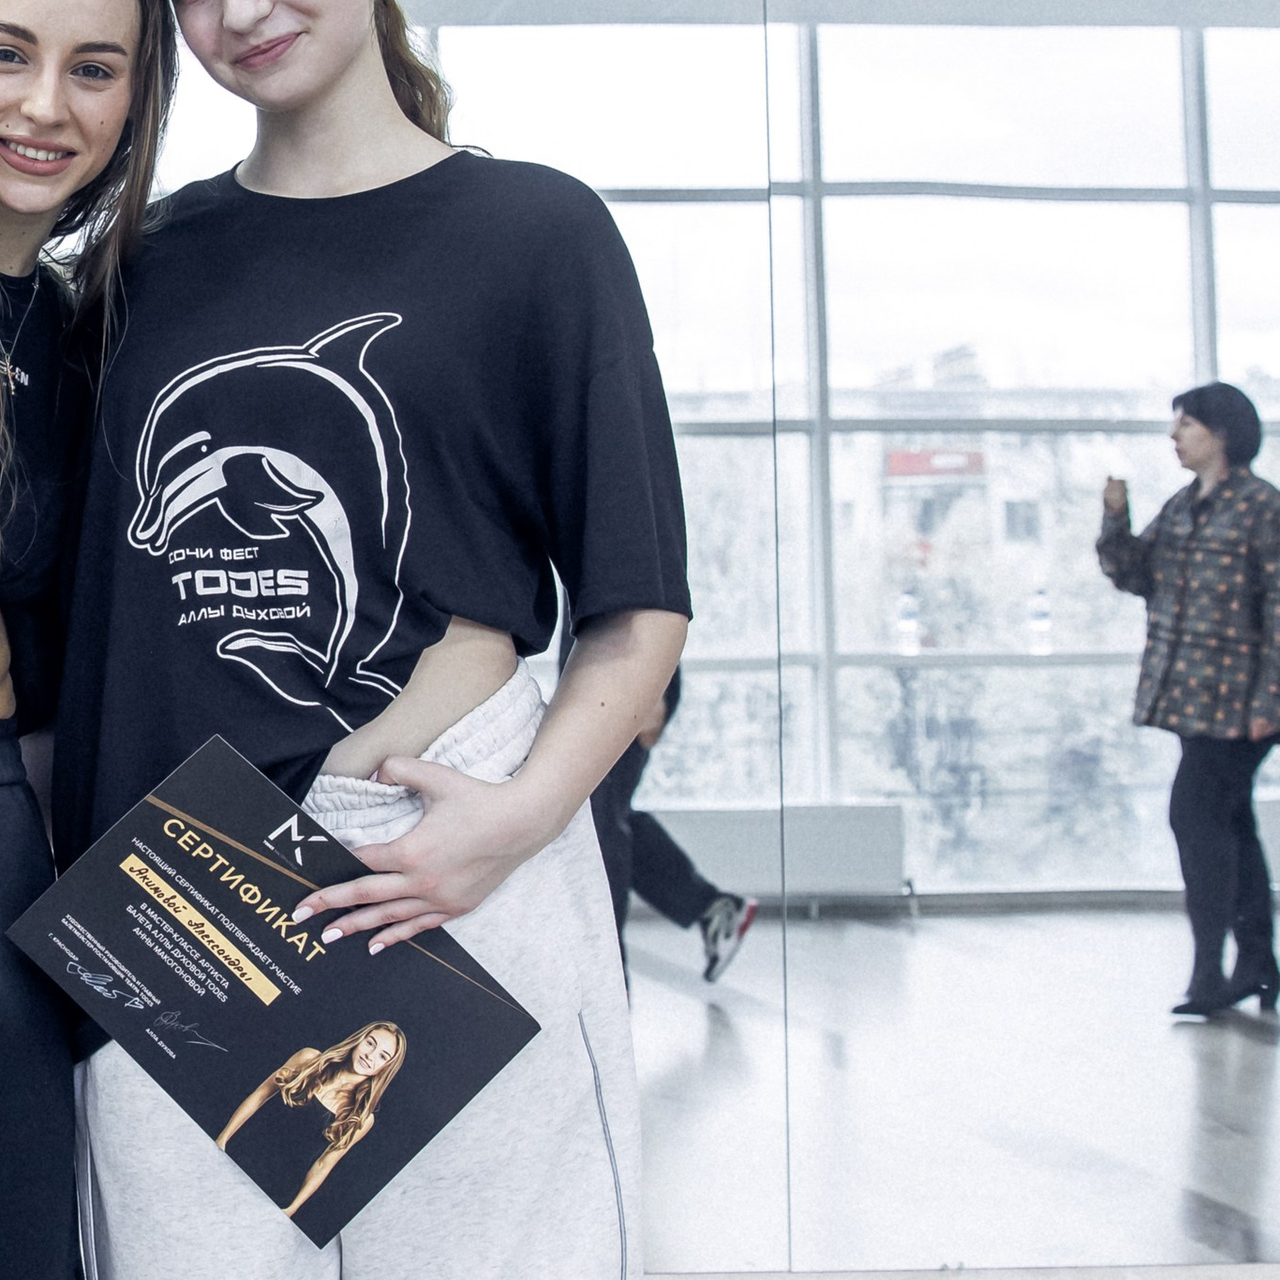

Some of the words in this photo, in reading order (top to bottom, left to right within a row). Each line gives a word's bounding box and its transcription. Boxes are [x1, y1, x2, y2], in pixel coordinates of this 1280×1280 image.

[171, 569, 309, 600] TODES
[220, 547, 259, 561] ФЕСТ
[178, 604, 225, 626] АЛЛЫ
[128, 866, 188, 914] Акимовой
[131, 837, 177, 877] НАСТОЯЩИЙ
[174, 874, 220, 916] СЕРТИФИКАТ
[217, 913, 272, 965] ПОДТВЕРЖДАЕТ
[269, 963, 302, 996] УЧАСТИЕ
[163, 818, 326, 962] СЕРТИФИКАТ
[126, 904, 153, 931] БАЛЕТА
[151, 929, 174, 951] АЛЛЫ
[170, 948, 207, 981] ДУХОВОЙ
[204, 979, 229, 1003] TODES
[132, 927, 155, 948] АННЫ
[153, 945, 206, 997] МАКОГОНОВОЙ
[140, 902, 148, 910] В
[146, 908, 201, 960] МАСТЕР-КЛАССЕ
[199, 959, 230, 989] АРТИСТА
